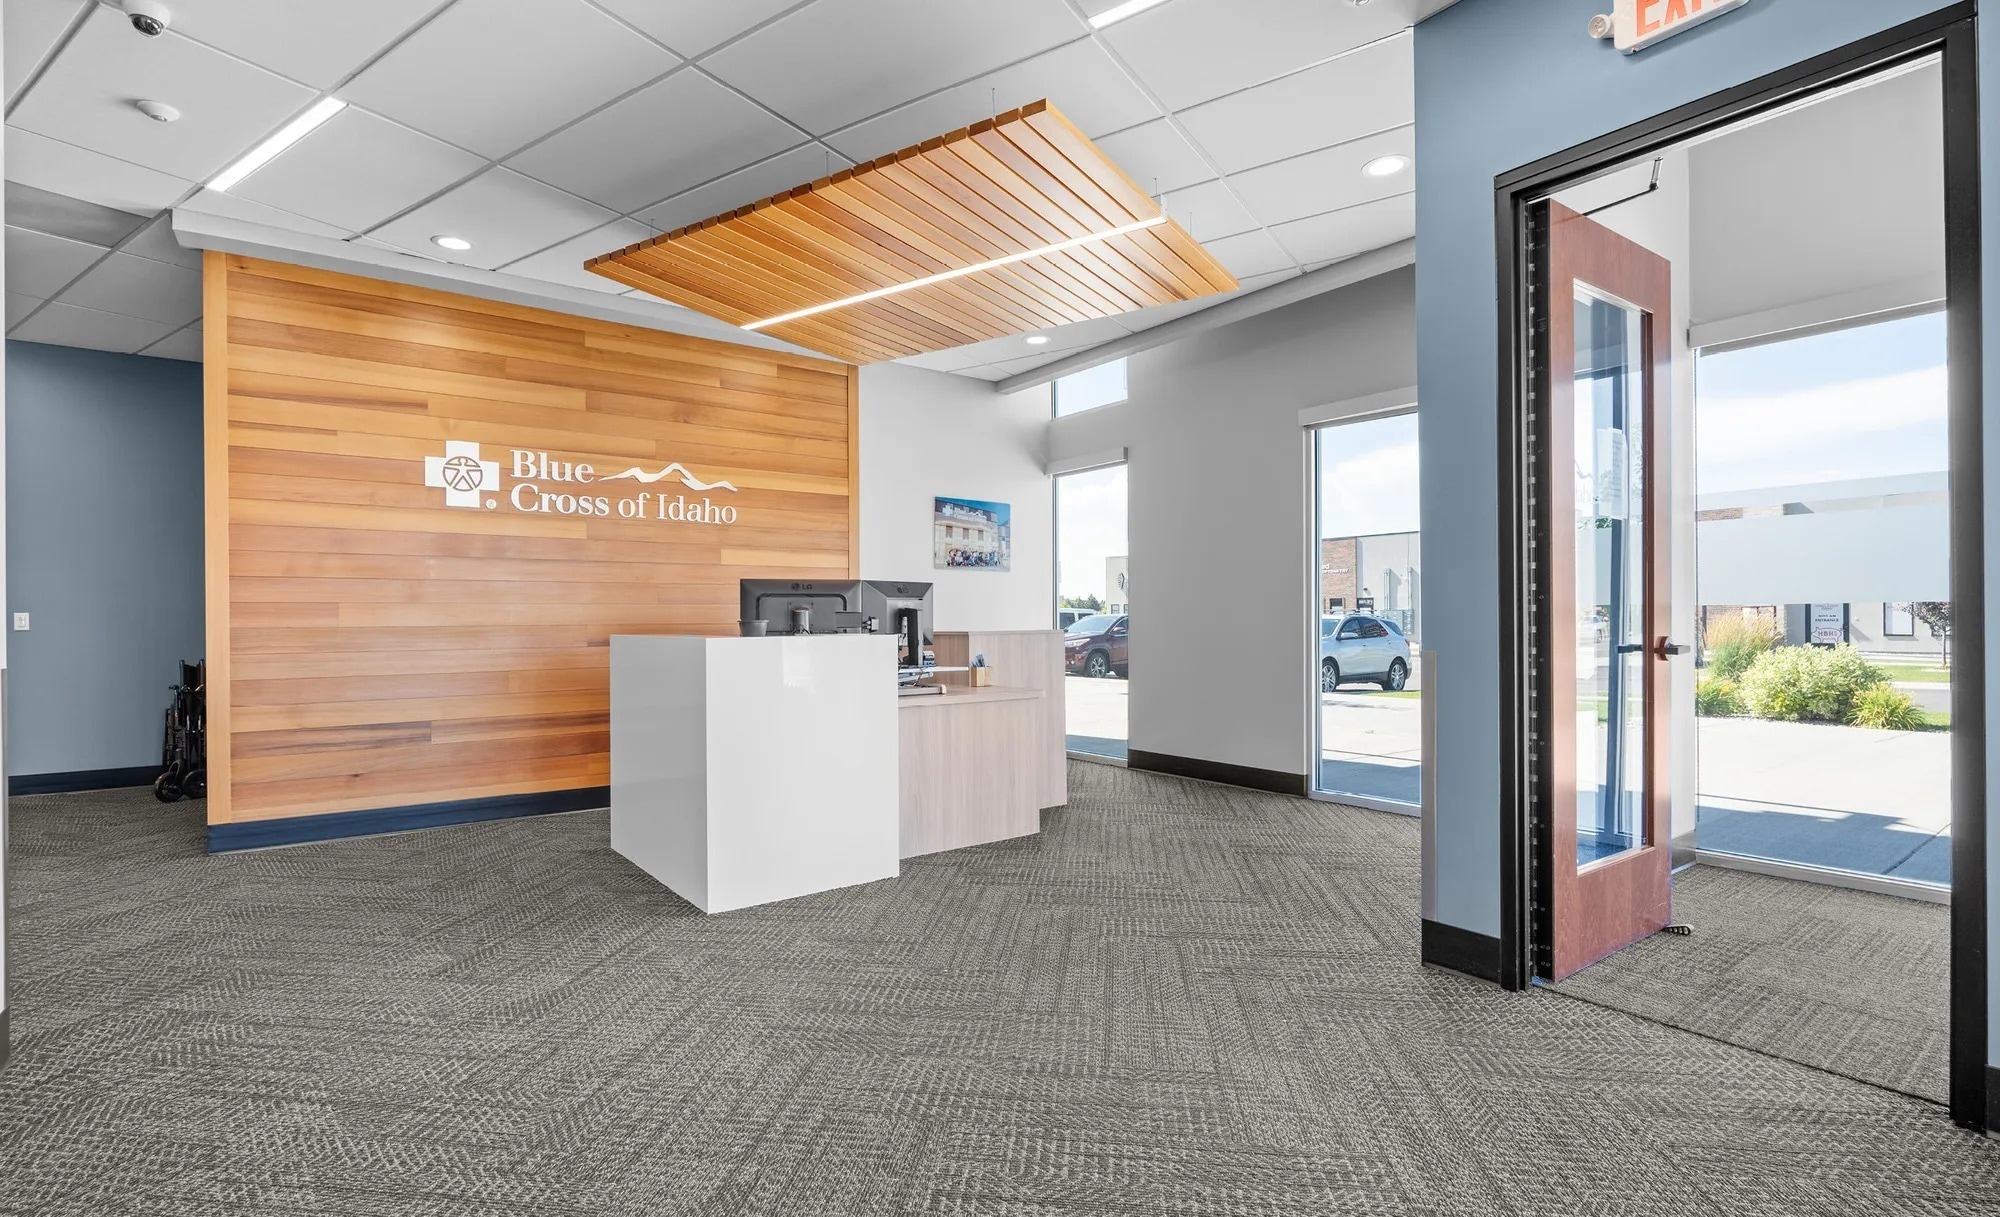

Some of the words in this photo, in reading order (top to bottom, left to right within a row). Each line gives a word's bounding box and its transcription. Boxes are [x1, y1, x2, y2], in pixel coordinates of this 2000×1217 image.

[510, 450, 594, 483] Blue
[511, 484, 609, 516] Cross
[617, 492, 651, 519] of
[656, 493, 738, 525] Idaho
